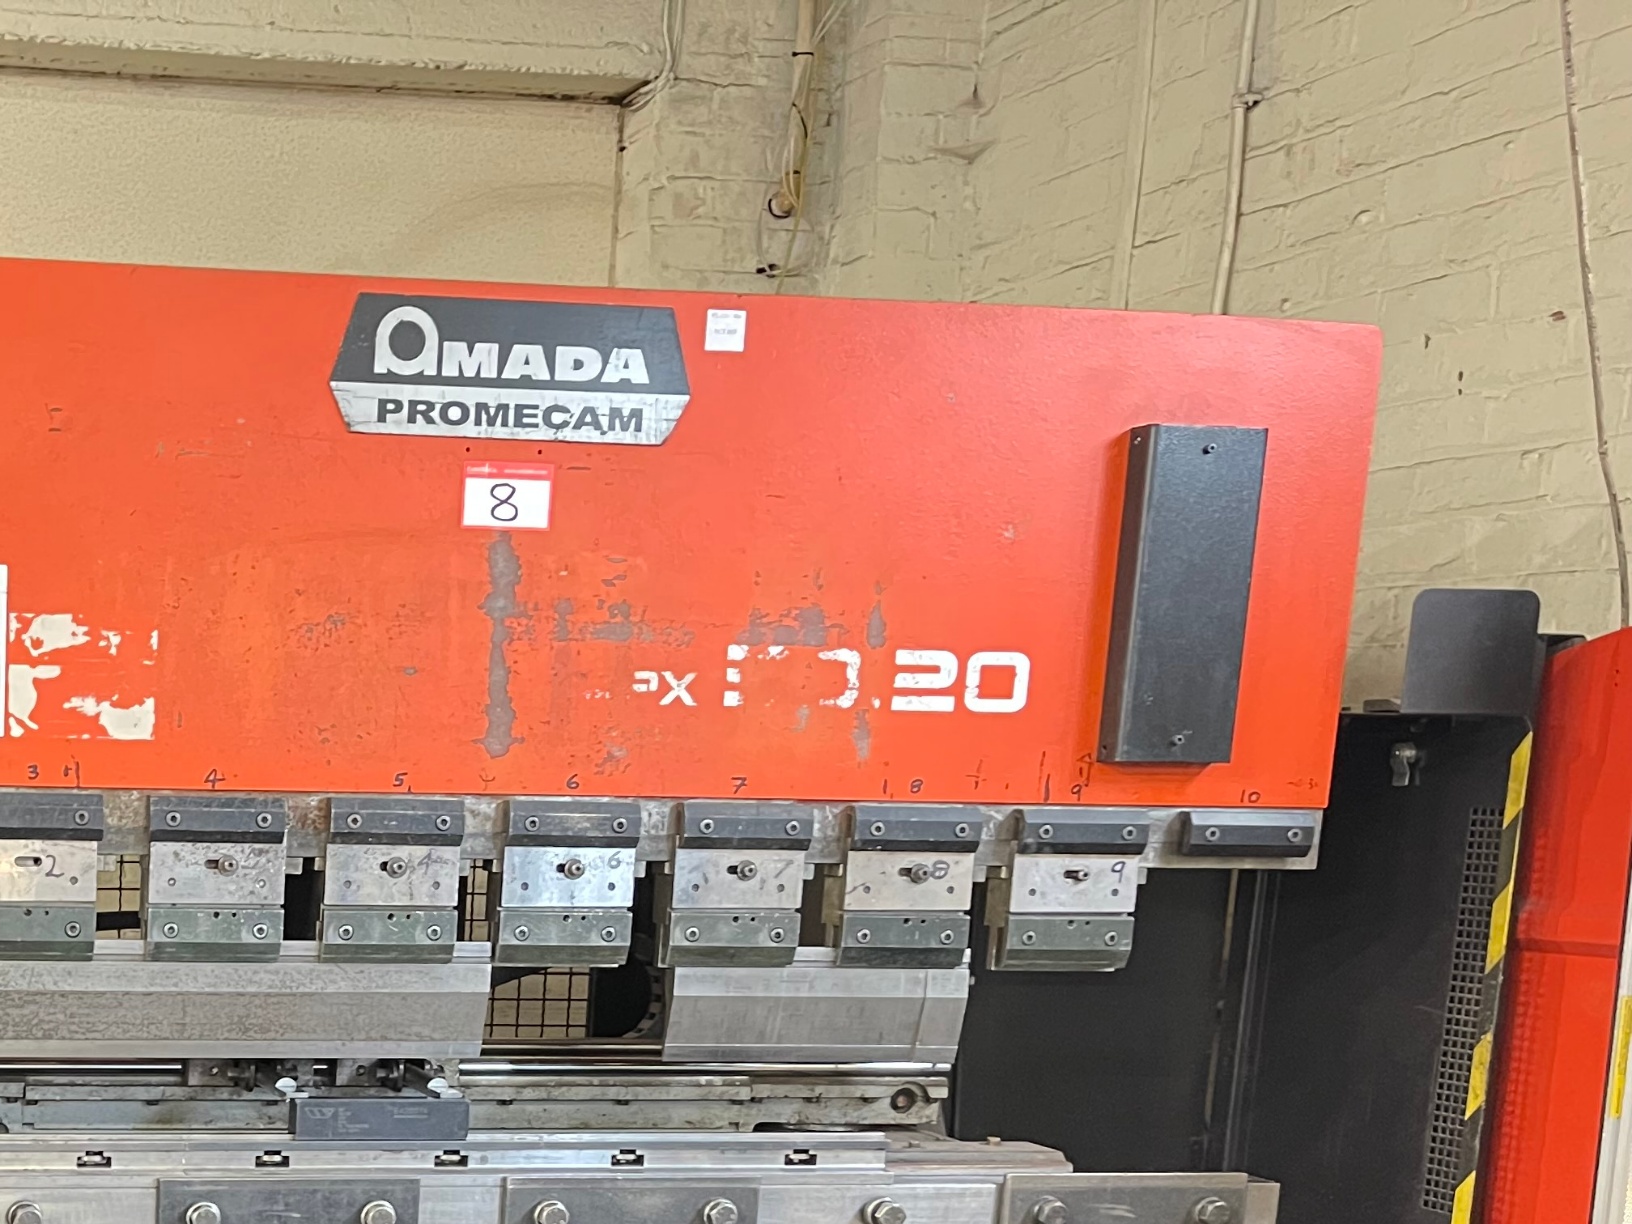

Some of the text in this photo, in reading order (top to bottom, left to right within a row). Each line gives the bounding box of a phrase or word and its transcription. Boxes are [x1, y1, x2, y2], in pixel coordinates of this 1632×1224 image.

[373, 304, 651, 385] AMADA
[489, 482, 519, 522] 8
[27, 764, 40, 781] 3
[204, 768, 226, 789] 4
[392, 771, 409, 788] 5
[565, 773, 581, 791] 6
[730, 776, 749, 795] 7
[909, 777, 924, 796] 8
[1070, 783, 1083, 802] 9
[1239, 788, 1262, 804] 10
[44, 854, 65, 879] 2
[607, 850, 624, 870] 6
[1110, 860, 1127, 884] 9
